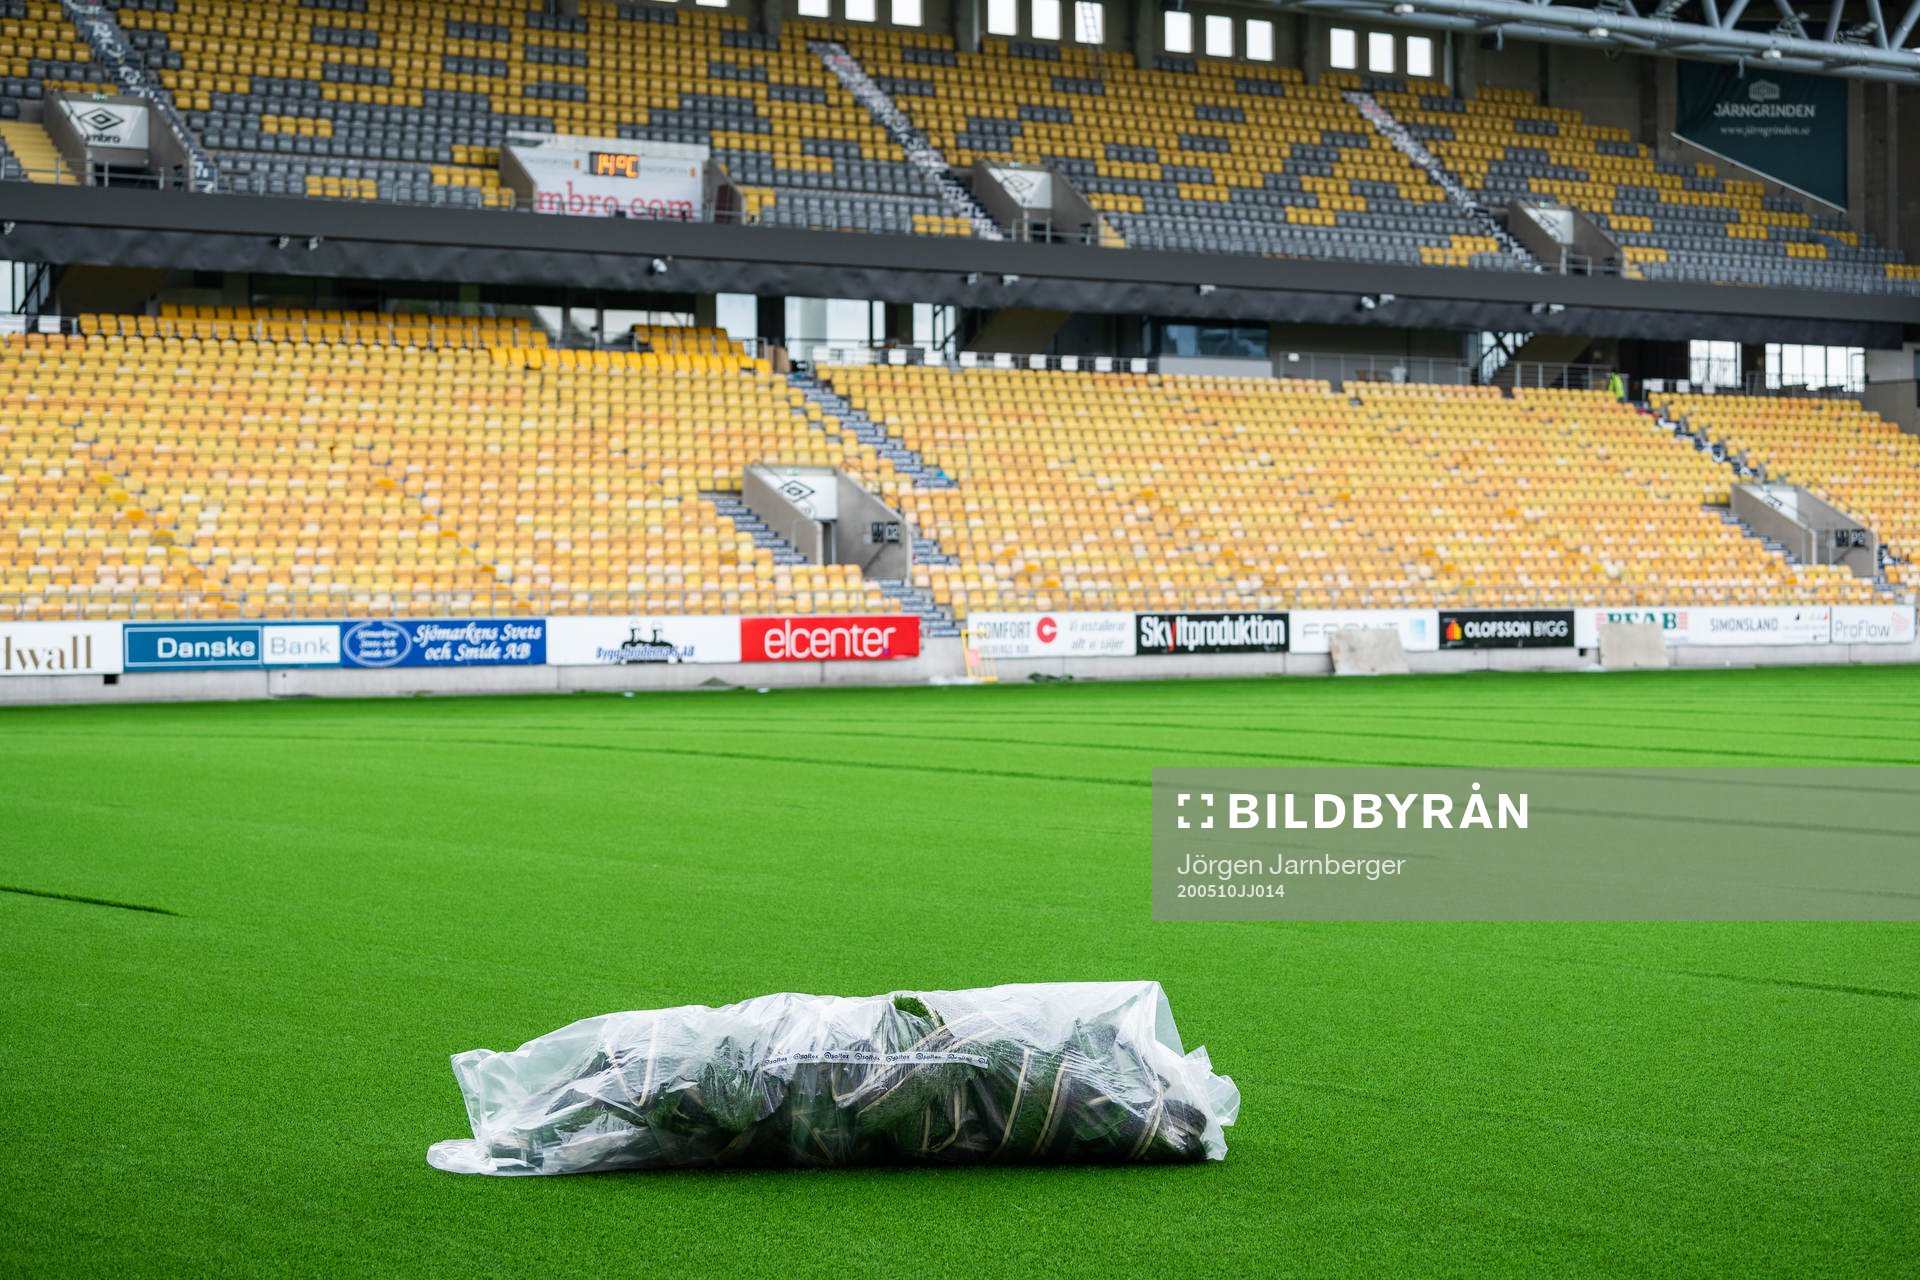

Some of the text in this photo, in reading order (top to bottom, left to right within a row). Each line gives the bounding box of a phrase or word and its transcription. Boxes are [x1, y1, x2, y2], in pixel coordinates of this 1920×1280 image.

[1713, 103, 1816, 118] JÄRNGRINDEN
[536, 180, 695, 220] mbrocom
[413, 622, 543, 647] Sjömarkens Svets
[977, 621, 1031, 639] COMFORT
[1140, 615, 1285, 652] Skyltproduktion
[1464, 619, 1569, 638] OLOFSSON BYGG
[1710, 616, 1779, 633] SIMONSLAND
[1835, 620, 1891, 639] ProFlow
[157, 635, 331, 659] Danske Bank
[764, 619, 897, 659] elcenter
[424, 641, 532, 662] och Smide AB
